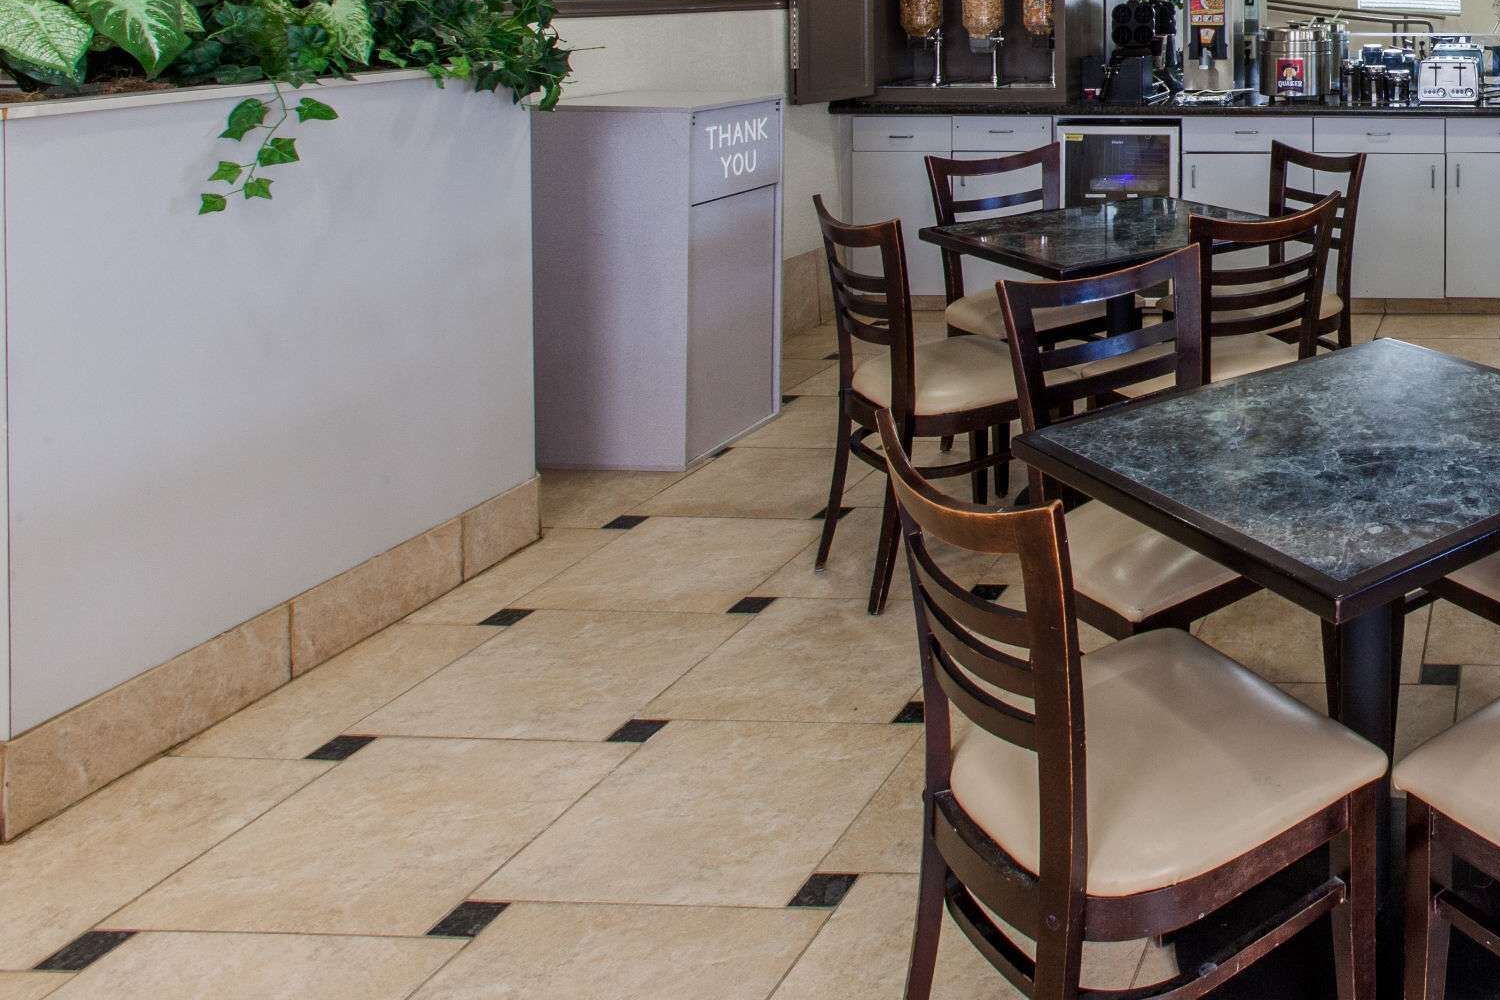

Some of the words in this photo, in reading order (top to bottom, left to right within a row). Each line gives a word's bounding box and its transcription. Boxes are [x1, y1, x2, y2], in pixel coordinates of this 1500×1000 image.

[1277, 80, 1303, 88] QUAKER
[705, 117, 768, 150] THANK
[720, 149, 757, 178] YOU
